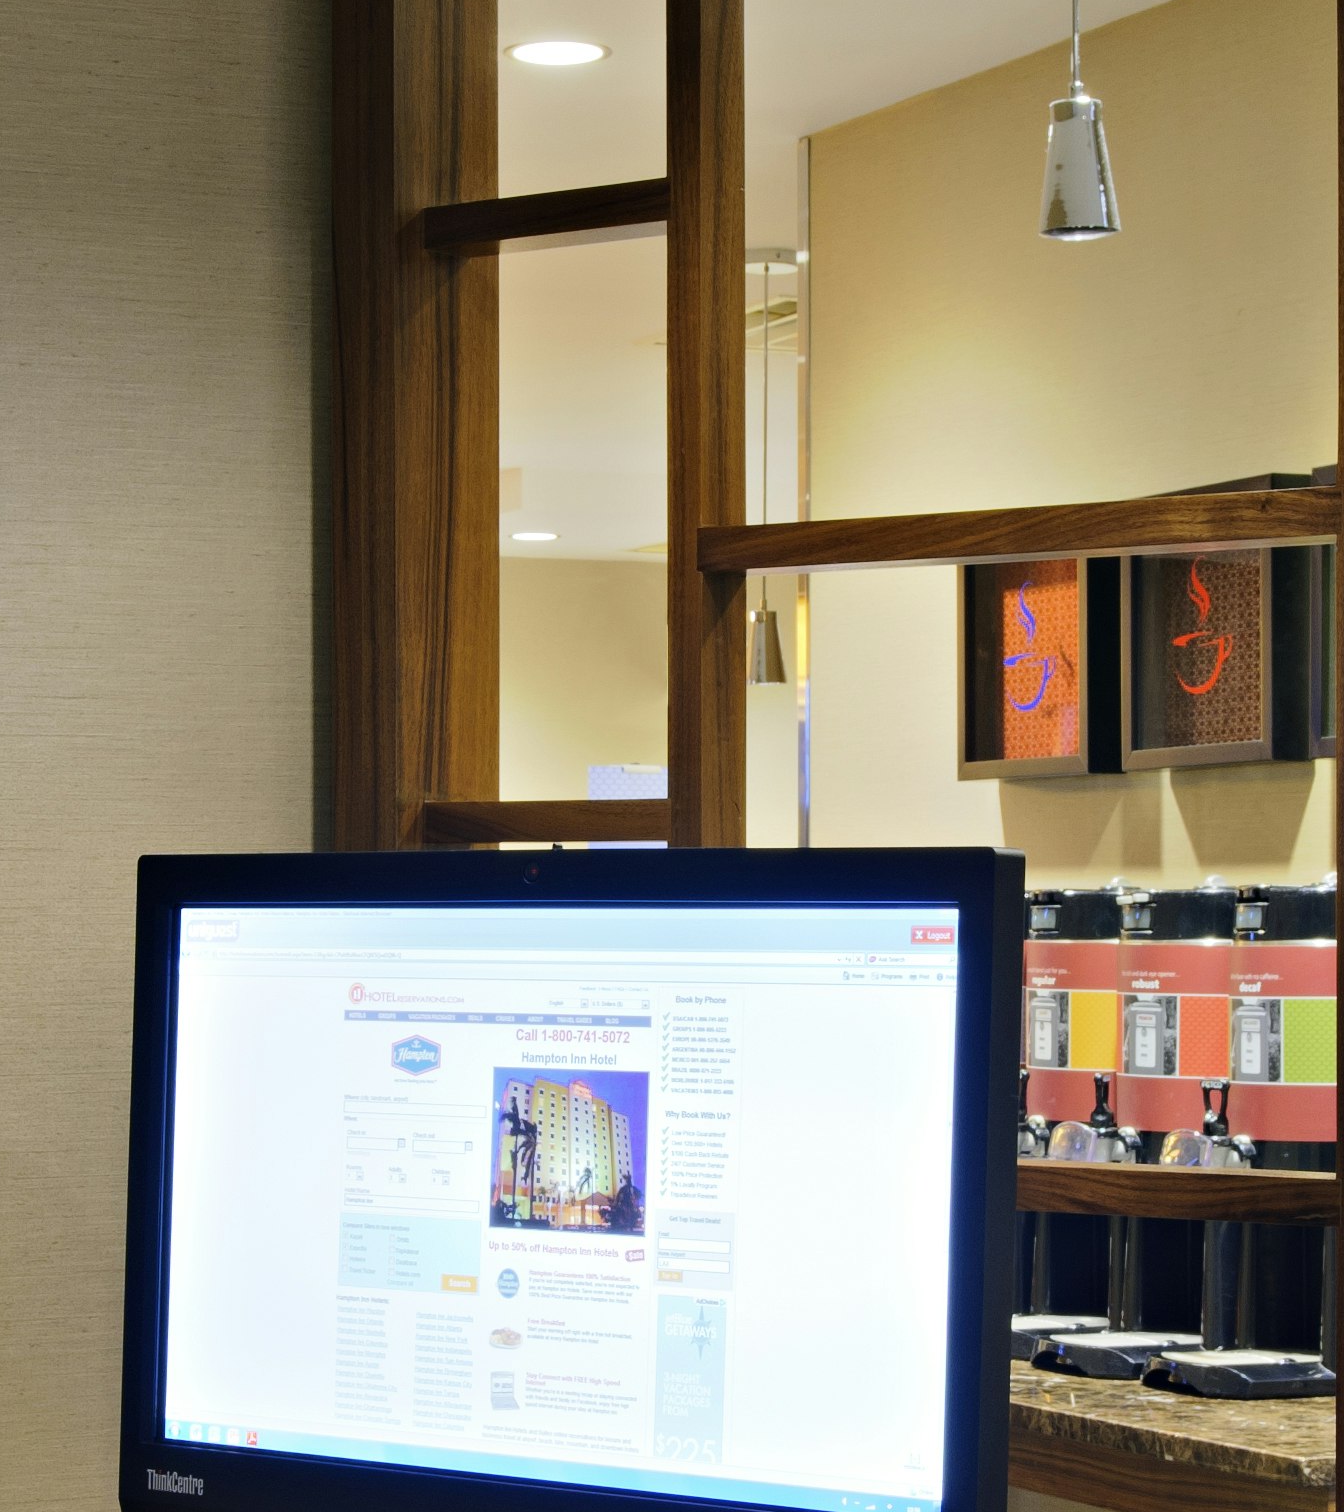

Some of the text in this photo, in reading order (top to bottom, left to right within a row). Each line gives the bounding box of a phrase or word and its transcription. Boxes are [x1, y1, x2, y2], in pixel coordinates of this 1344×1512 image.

[927, 930, 951, 941] Logout
[1131, 978, 1160, 989] robust
[1239, 981, 1262, 993] decaf
[675, 996, 727, 1005] Book Phone
[516, 1028, 631, 1044] Call 1-800-741-5072
[395, 1046, 438, 1065] Hampton
[522, 1052, 617, 1066] Hampton Inn Hotel
[665, 1111, 731, 1120] Why Book With Us?
[488, 1241, 500, 1252] Up
[511, 1243, 528, 1252] 50%
[529, 1244, 540, 1253] off
[542, 1244, 577, 1256] Hampton
[579, 1247, 592, 1256] Inn
[594, 1248, 619, 1258] Hotels
[448, 1278, 471, 1288] Search
[665, 1325, 717, 1339] GETAWAYS
[663, 1383, 711, 1397] VACATION
[663, 1395, 711, 1409] PACKAGES
[663, 1405, 689, 1418] FROM
[656, 1433, 717, 1464] $225
[146, 1468, 204, 1496] ThinkCentre
